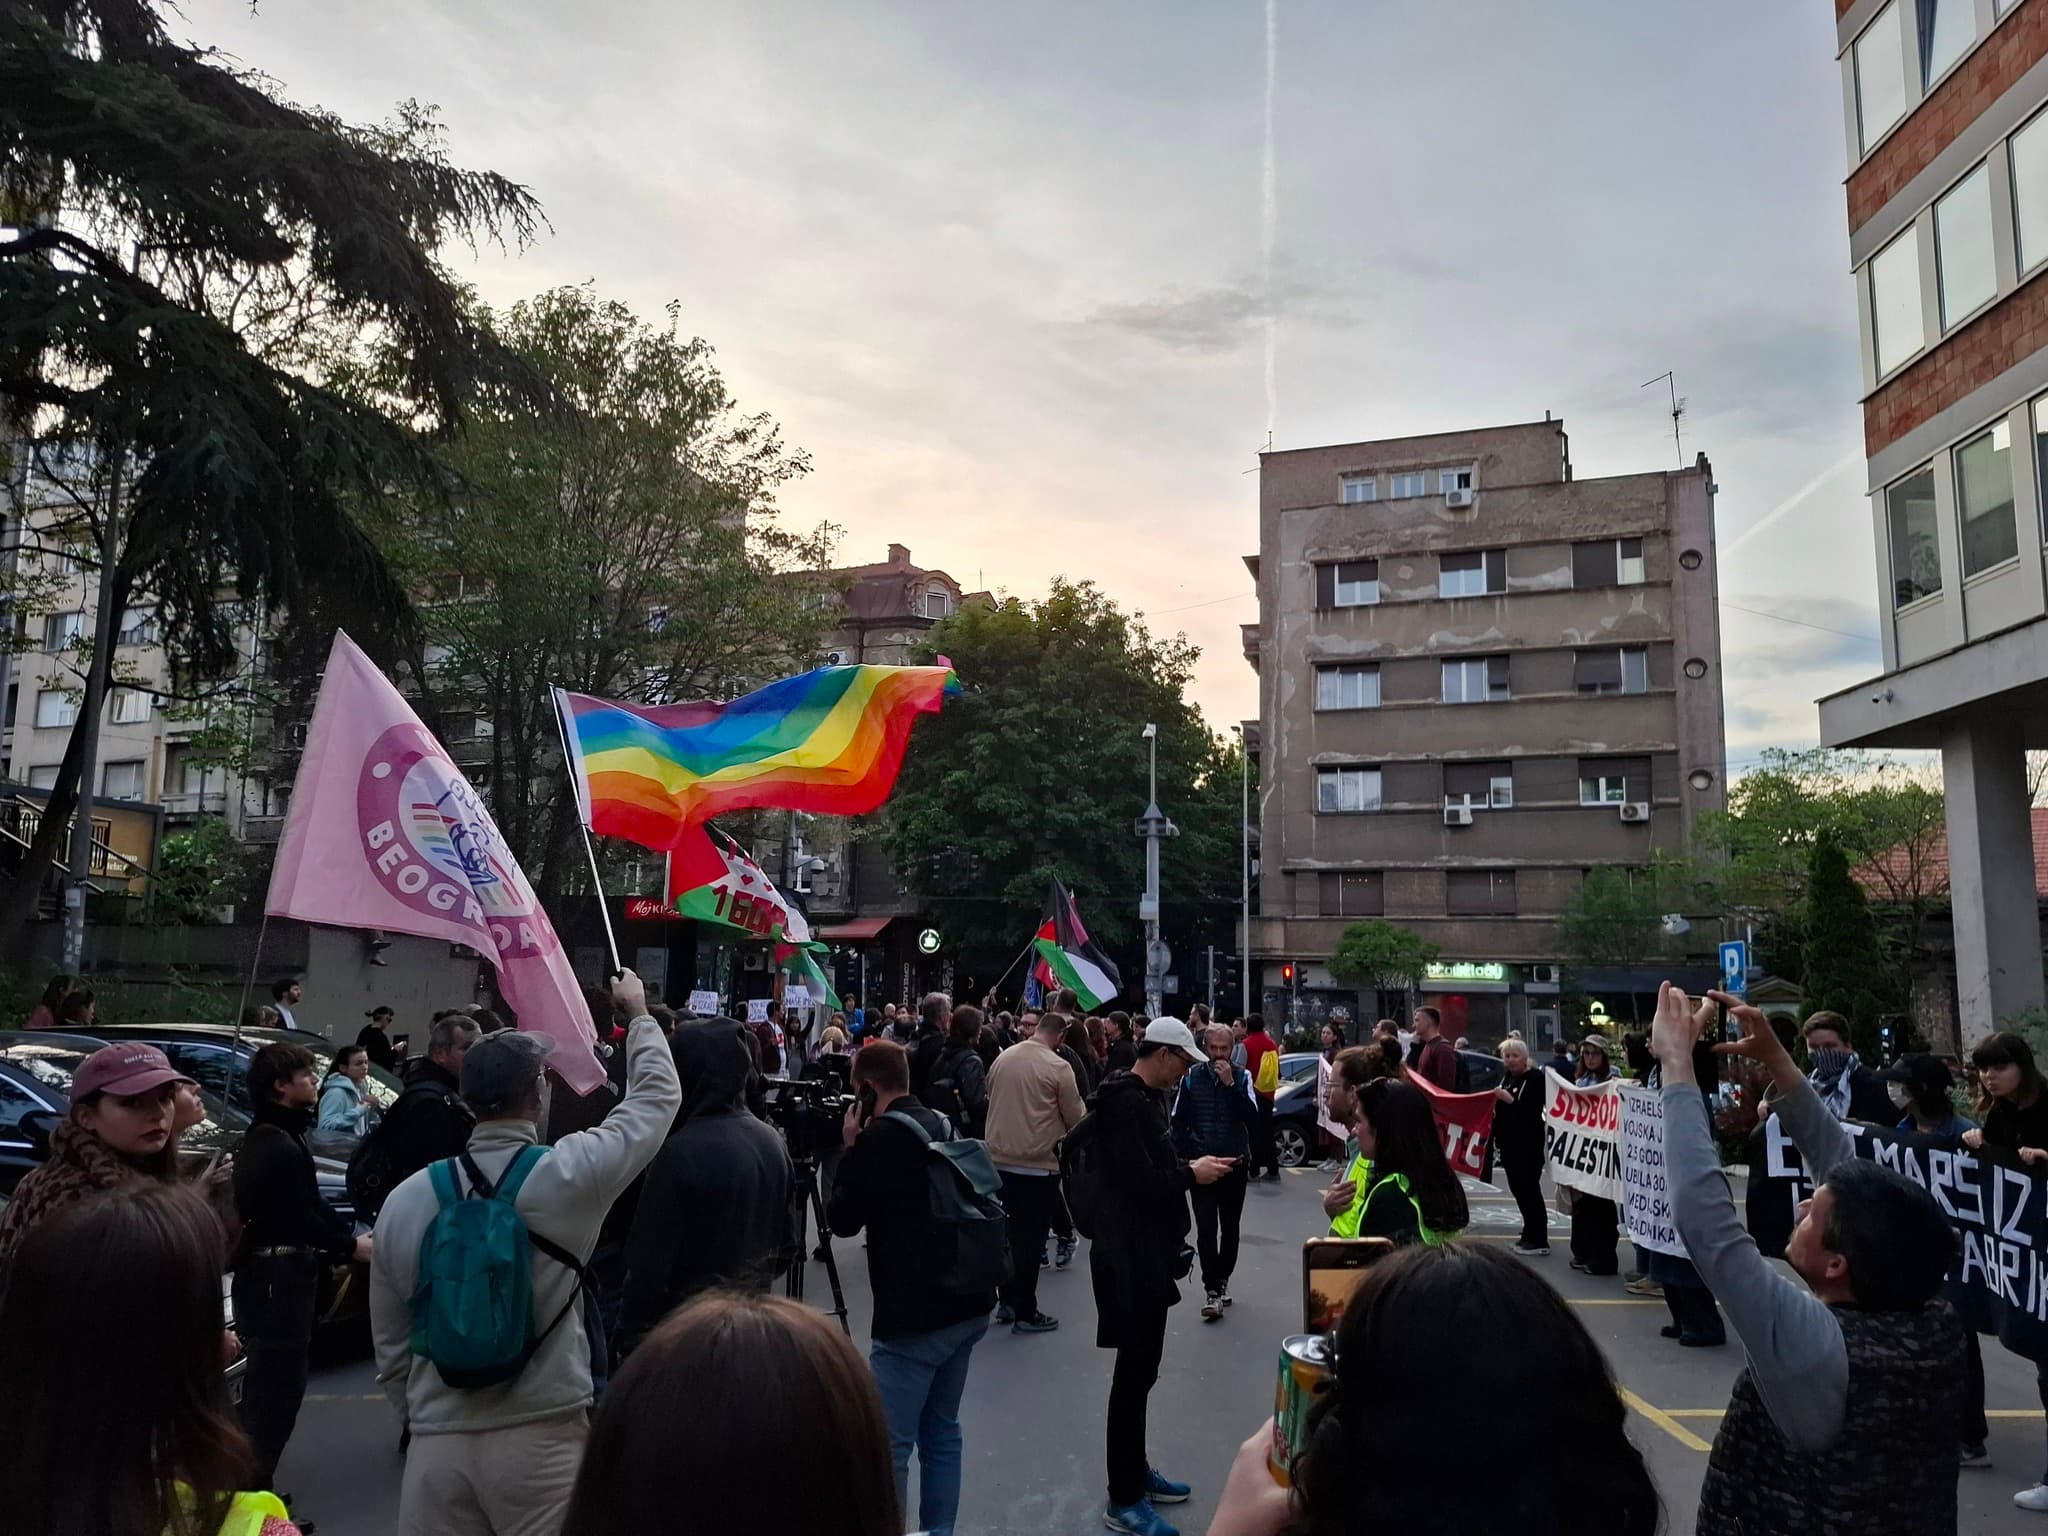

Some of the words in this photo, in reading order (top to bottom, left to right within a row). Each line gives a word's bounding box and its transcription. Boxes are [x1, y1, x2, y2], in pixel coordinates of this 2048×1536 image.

[1725, 948, 1739, 984] P
[1549, 1086, 1619, 1131] SLOBOD
[1623, 1119, 1655, 1141] VOJSKA
[1993, 1164, 2032, 1246] IZ
